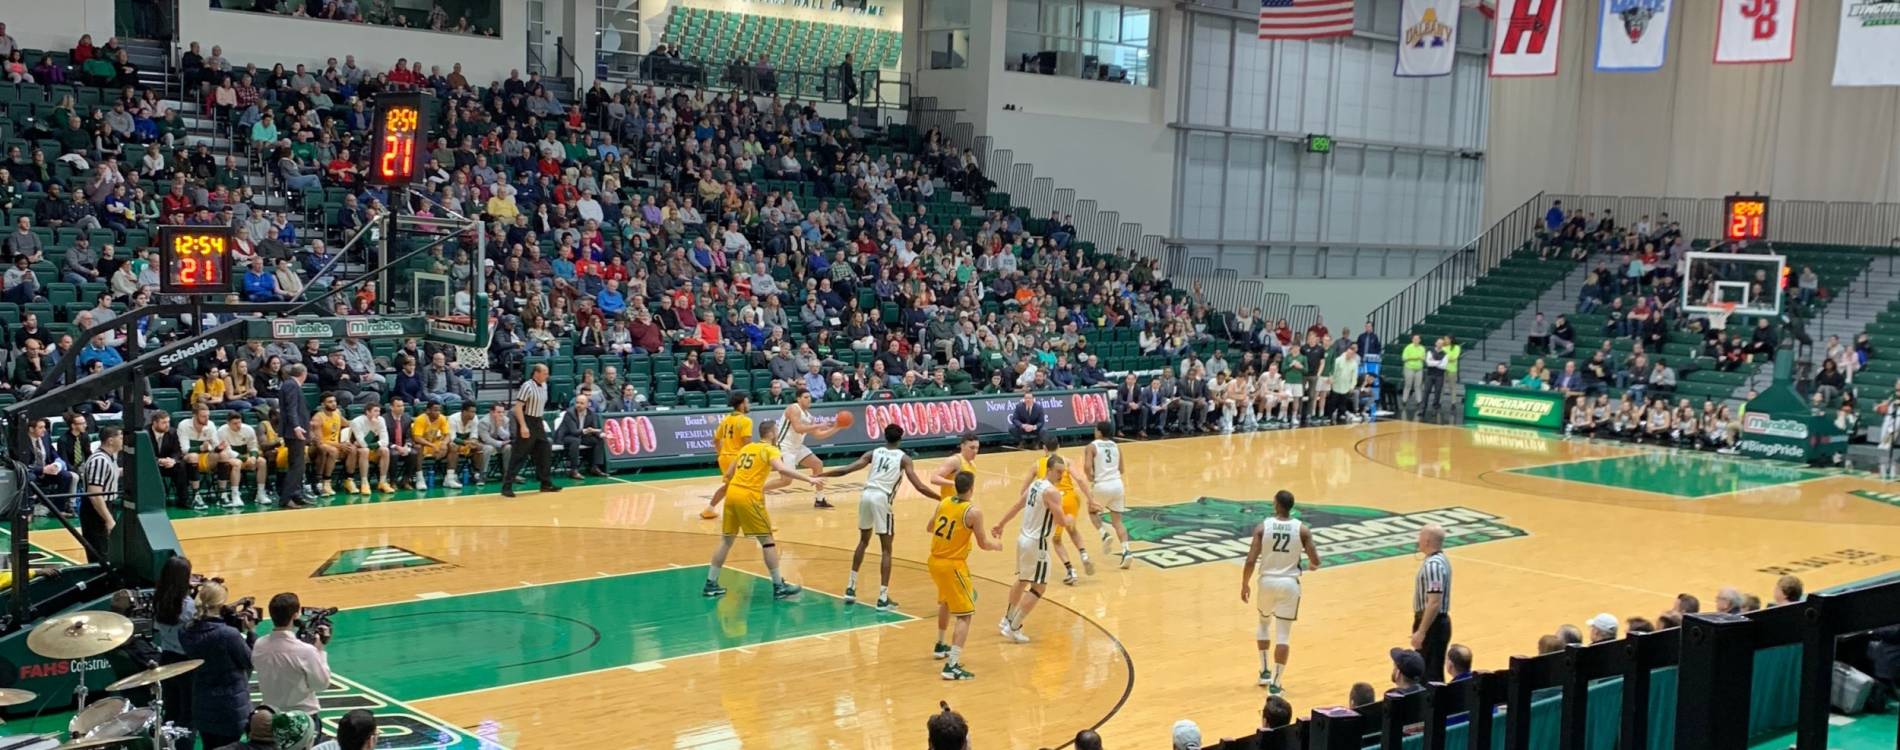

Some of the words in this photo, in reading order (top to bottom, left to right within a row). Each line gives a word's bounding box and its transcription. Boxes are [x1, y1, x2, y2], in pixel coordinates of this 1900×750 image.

[382, 135, 412, 176] 21
[1733, 216, 1760, 236] 21
[175, 235, 223, 254] 12:54
[180, 258, 212, 283] 21
[158, 338, 218, 367] Schelde
[675, 429, 713, 439] PREMIUM
[1105, 449, 1112, 463] 3
[1741, 440, 1804, 457] #BingPride
[737, 453, 756, 469] 35
[877, 457, 890, 472] 14
[935, 516, 956, 540] 21
[1272, 533, 1290, 552] 22
[20, 661, 69, 679] FAHS
